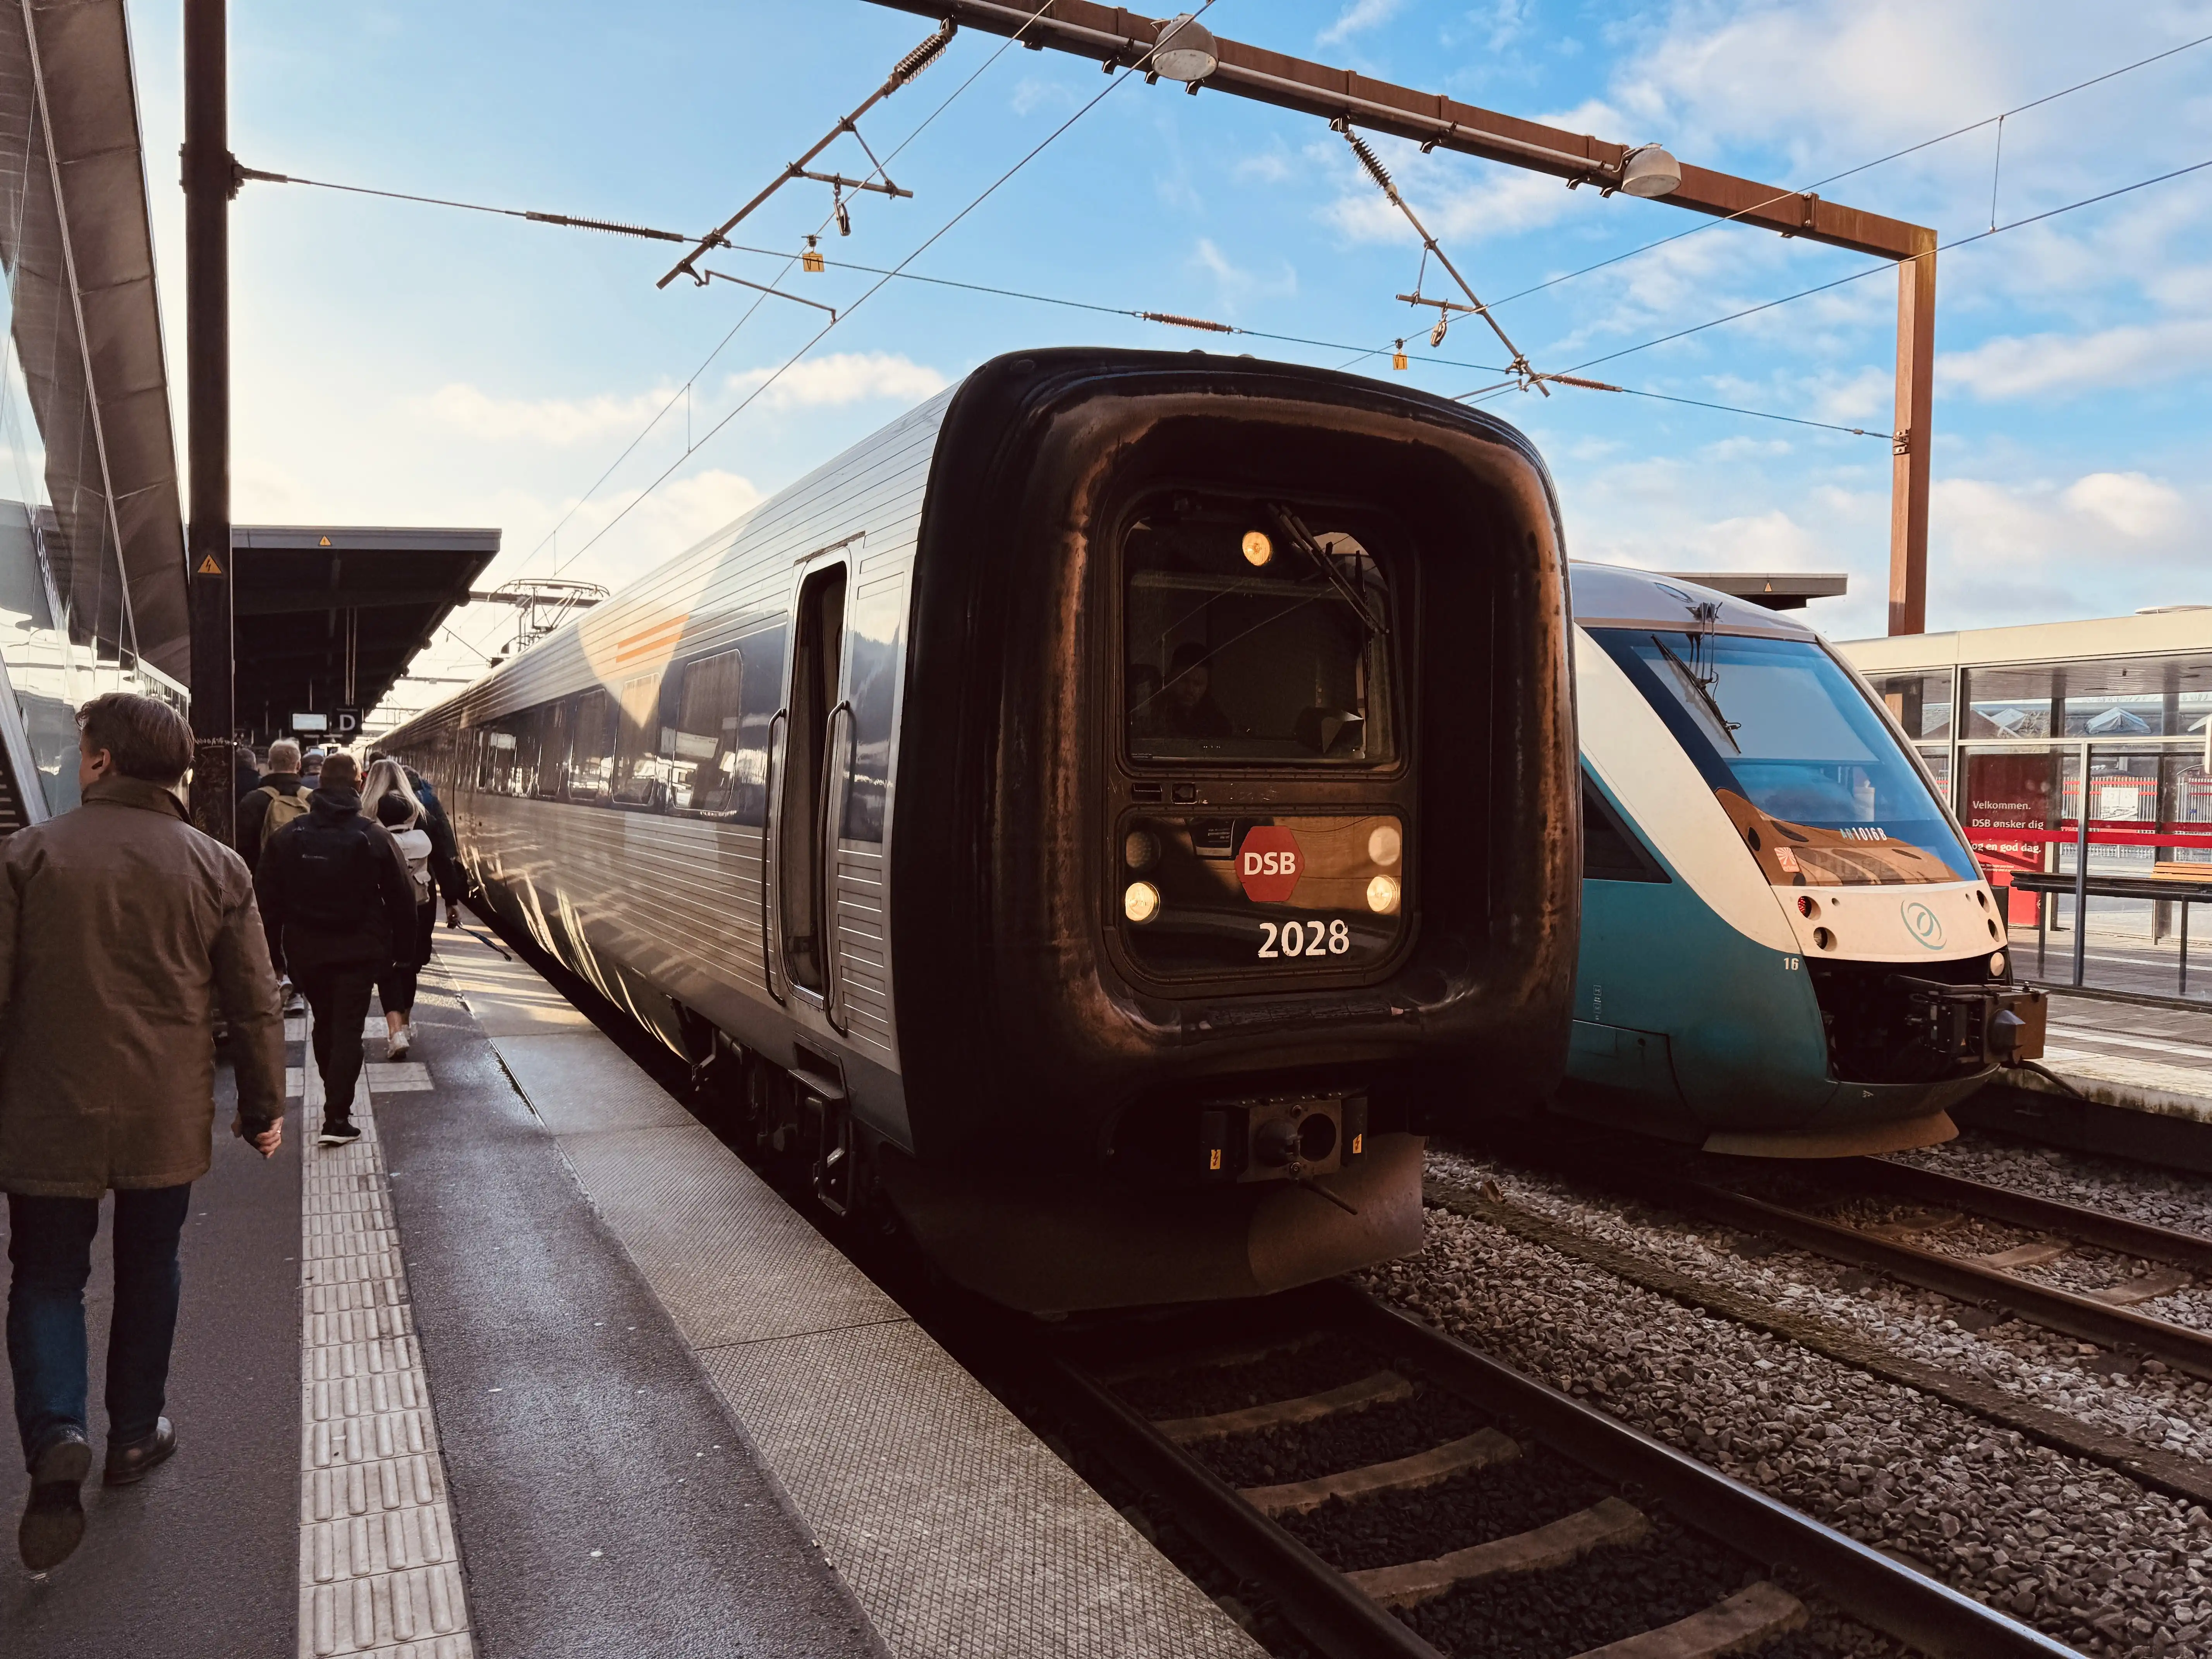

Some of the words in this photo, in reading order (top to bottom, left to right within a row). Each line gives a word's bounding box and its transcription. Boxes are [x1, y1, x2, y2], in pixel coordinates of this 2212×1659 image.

[340, 714, 356, 731] D
[1972, 800, 2031, 809] Velkommen.
[1972, 819, 1990, 827] DSB
[1993, 819, 2026, 828] ønsker
[2028, 820, 2044, 830] dig
[1972, 843, 1984, 851] og
[2000, 843, 2018, 852] god
[2020, 843, 2041, 854] dag.
[1243, 852, 1296, 876] DSB
[1257, 919, 1350, 958] 2028
[1783, 957, 1799, 970] 16
